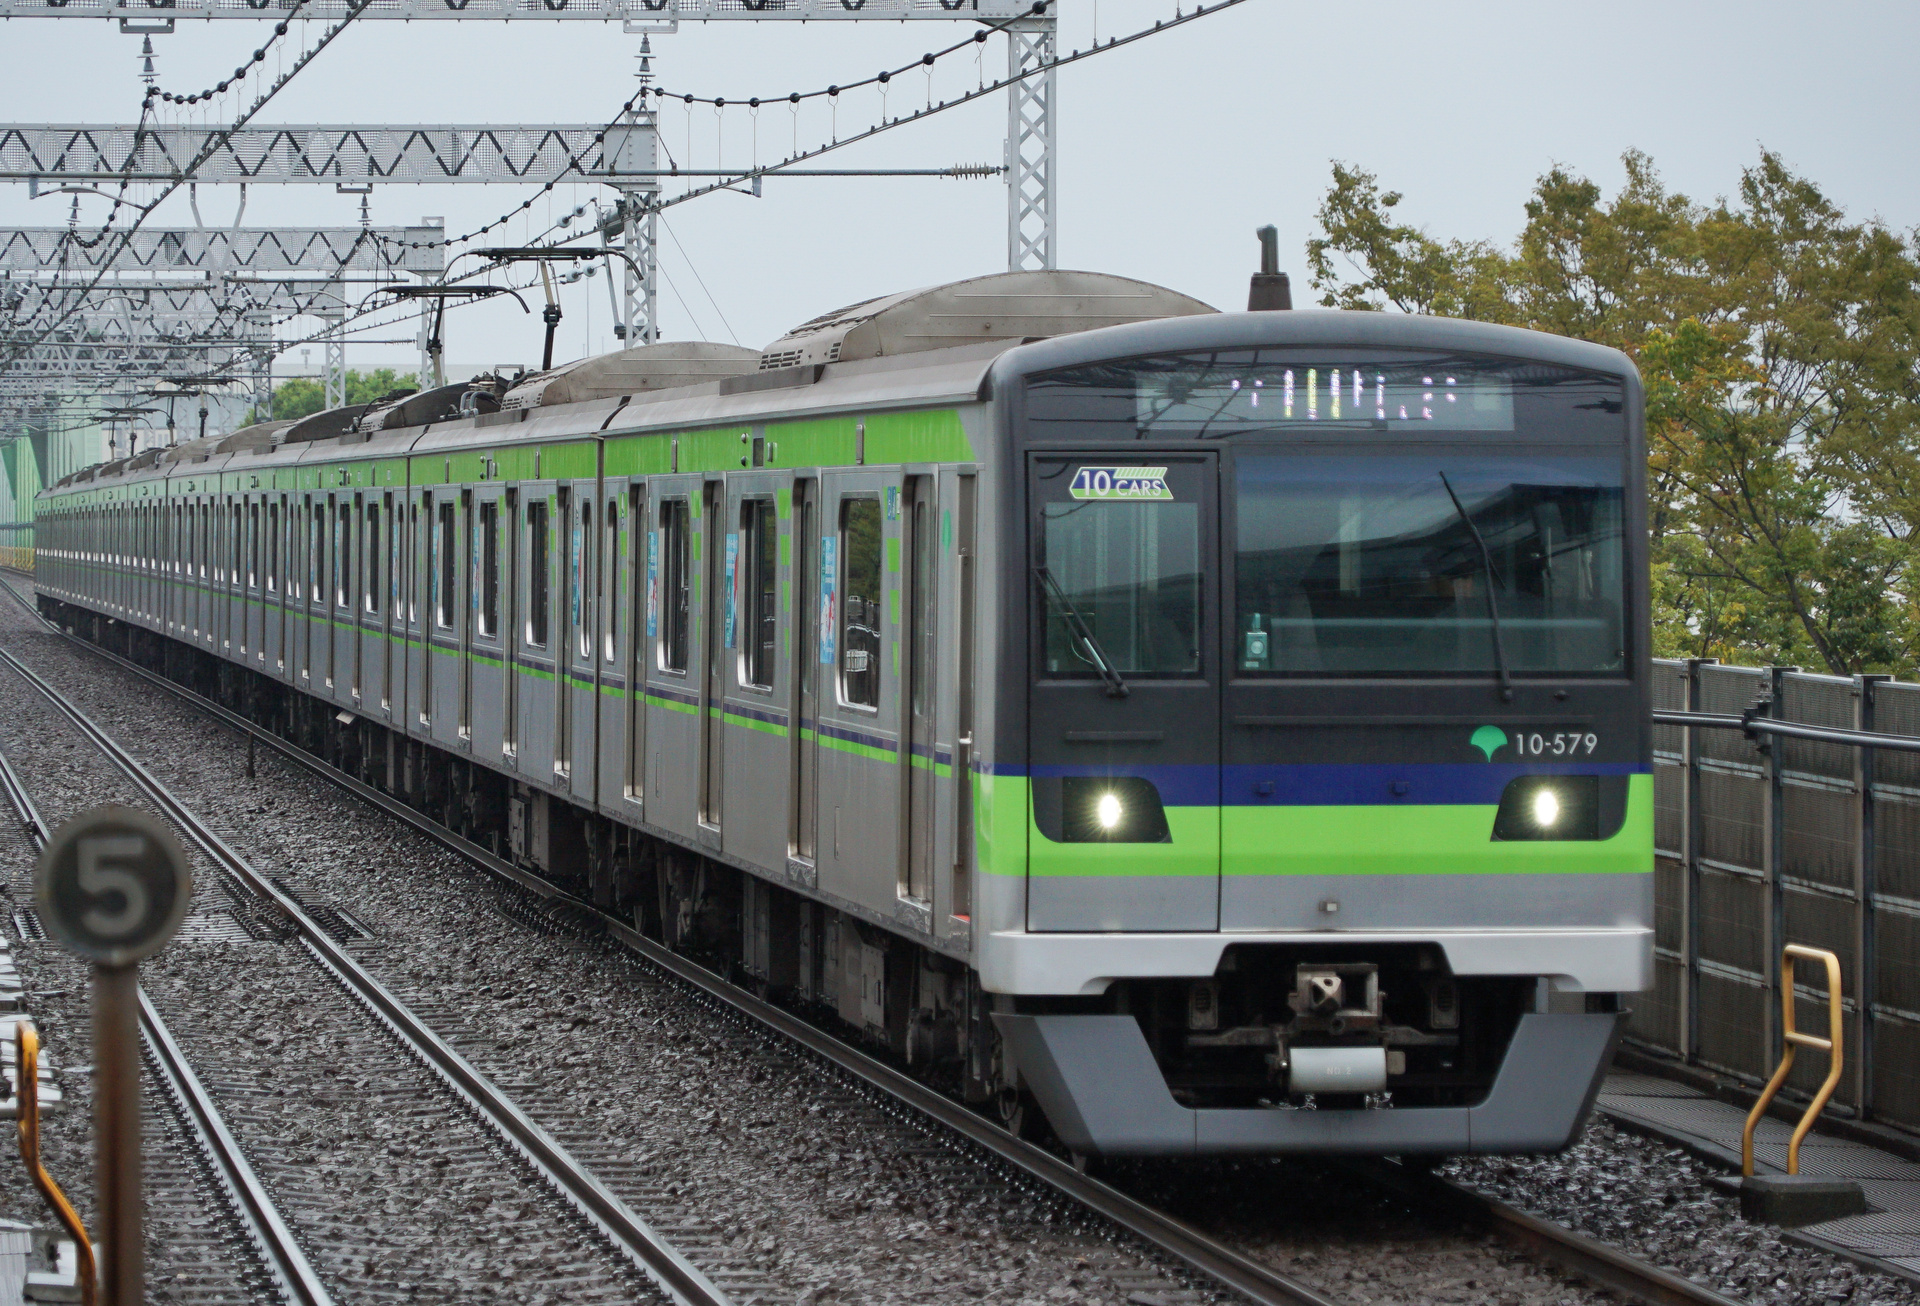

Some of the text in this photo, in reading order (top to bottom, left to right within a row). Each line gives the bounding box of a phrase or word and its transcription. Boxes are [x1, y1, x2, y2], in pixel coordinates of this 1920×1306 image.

[1081, 470, 1162, 496] 10 CARS
[1516, 733, 1598, 755] 10-579
[78, 837, 146, 936] 5
